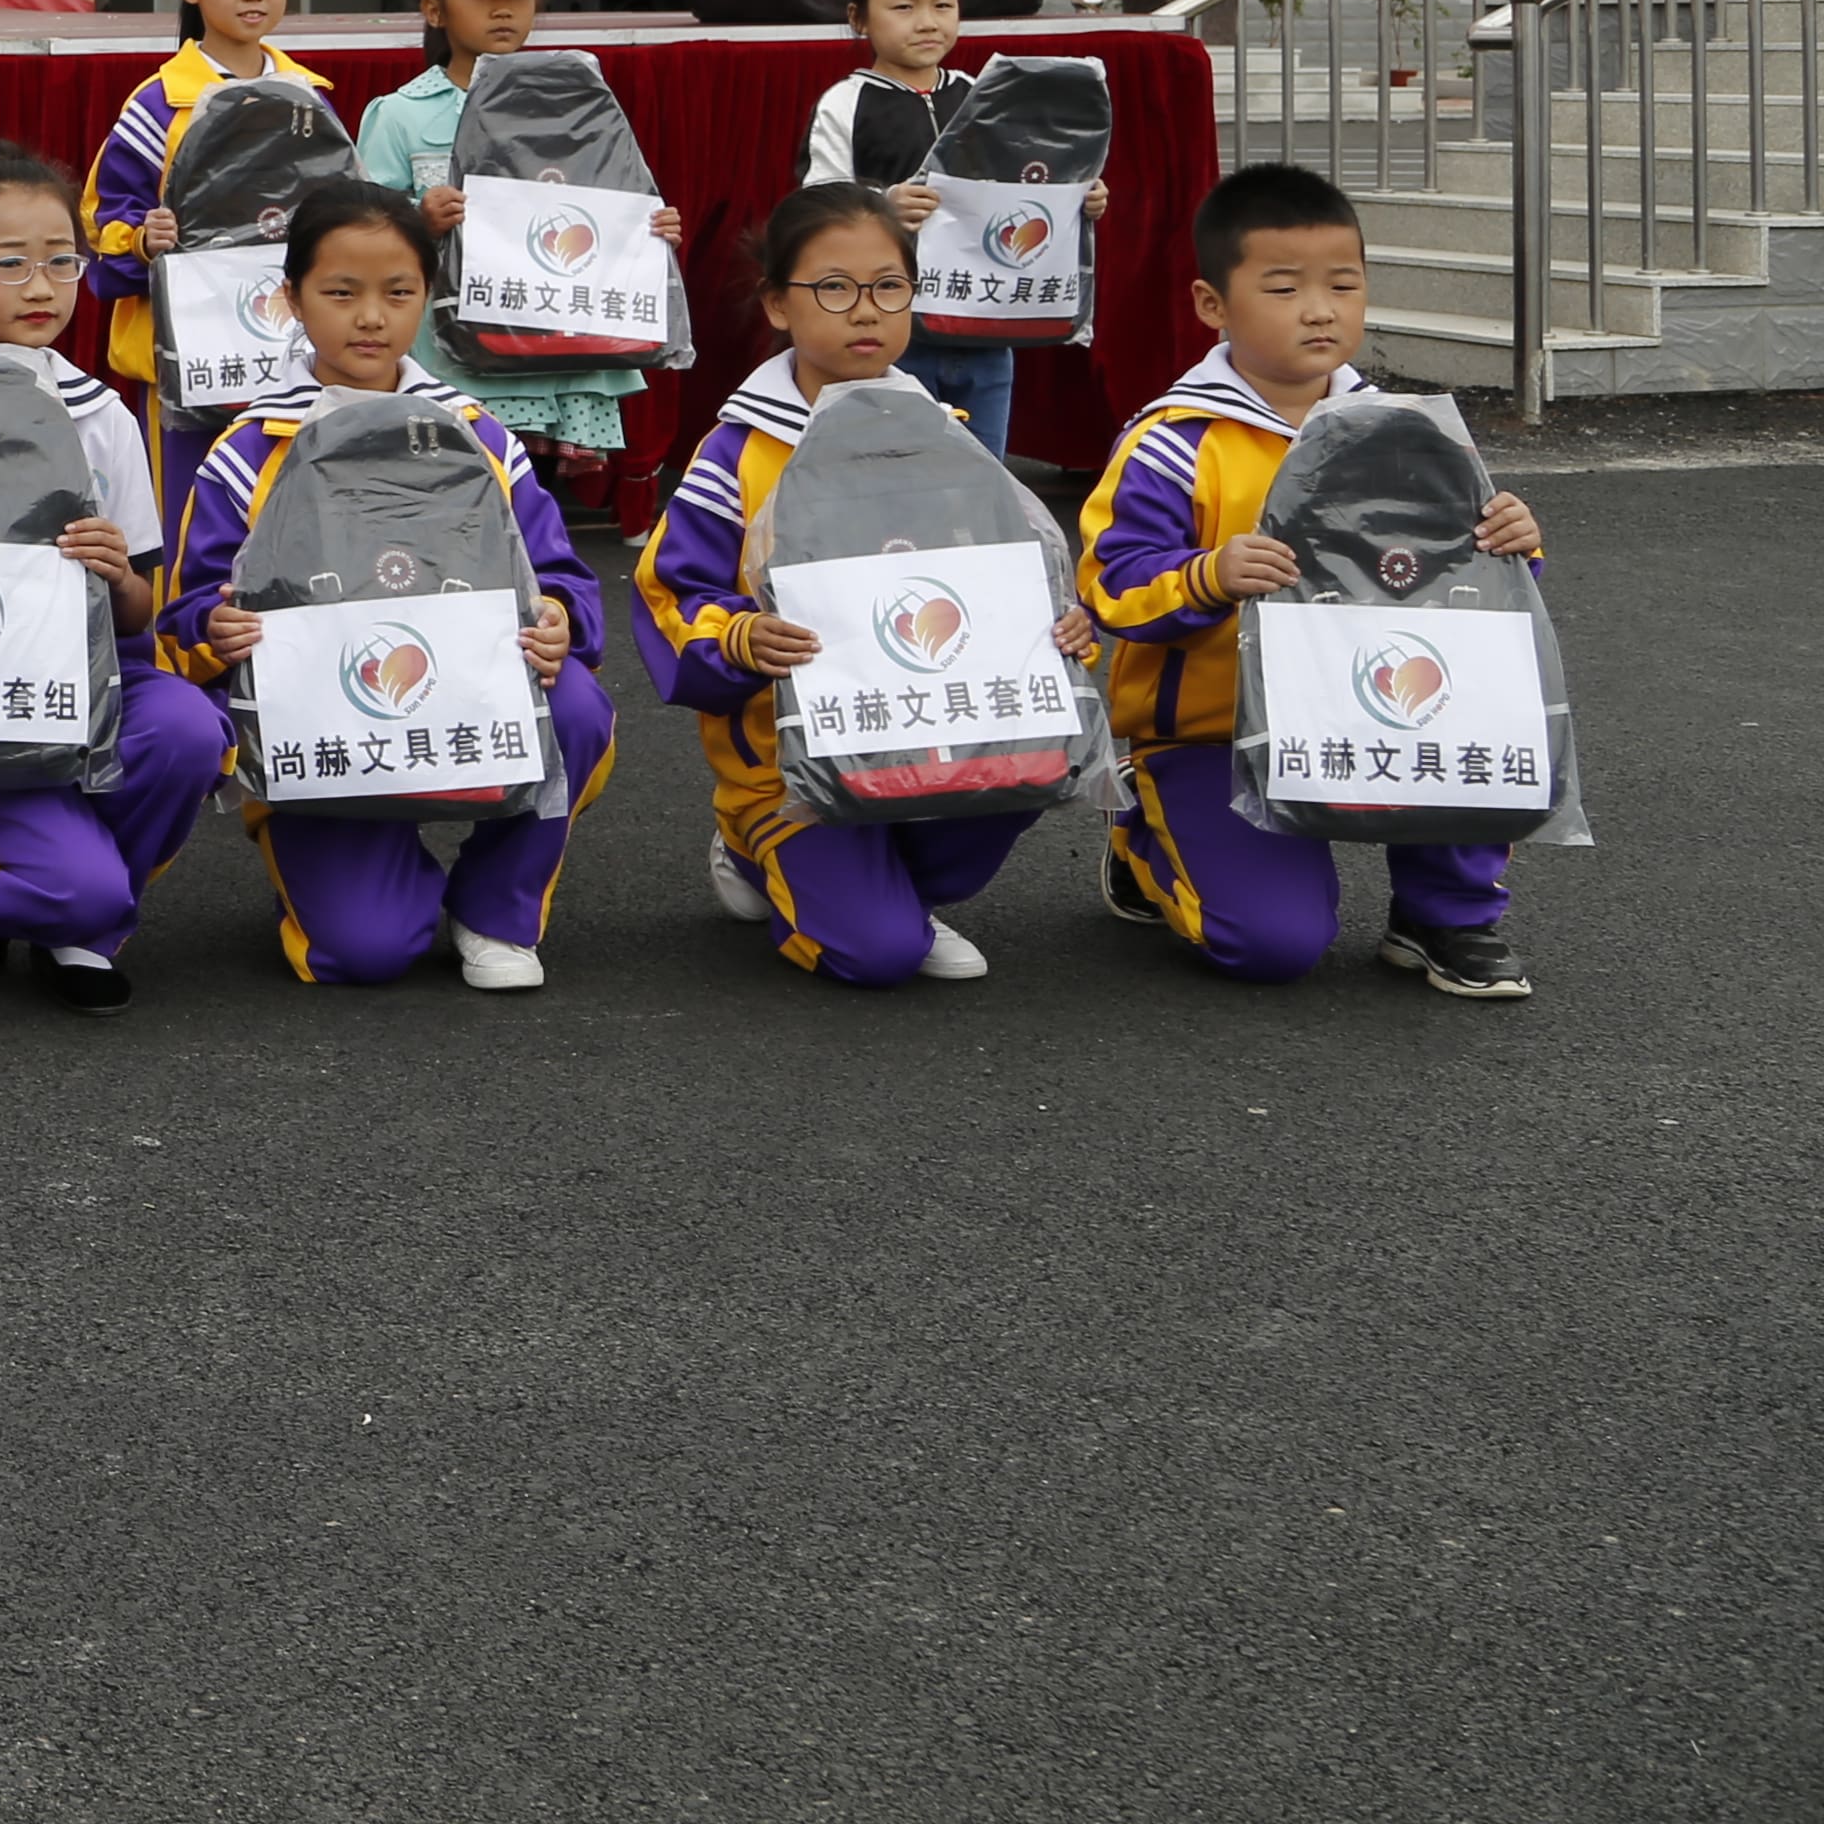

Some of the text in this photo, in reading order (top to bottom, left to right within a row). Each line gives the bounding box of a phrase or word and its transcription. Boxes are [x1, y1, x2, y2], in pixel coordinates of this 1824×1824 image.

[466, 275, 659, 325] 尚赫文具套组
[186, 350, 296, 391] 尚赫文
[808, 673, 1066, 737] 尚赫文具套组
[271, 720, 529, 783] 尚赫文具套组
[1277, 736, 1540, 786] 尚赫文具套组
